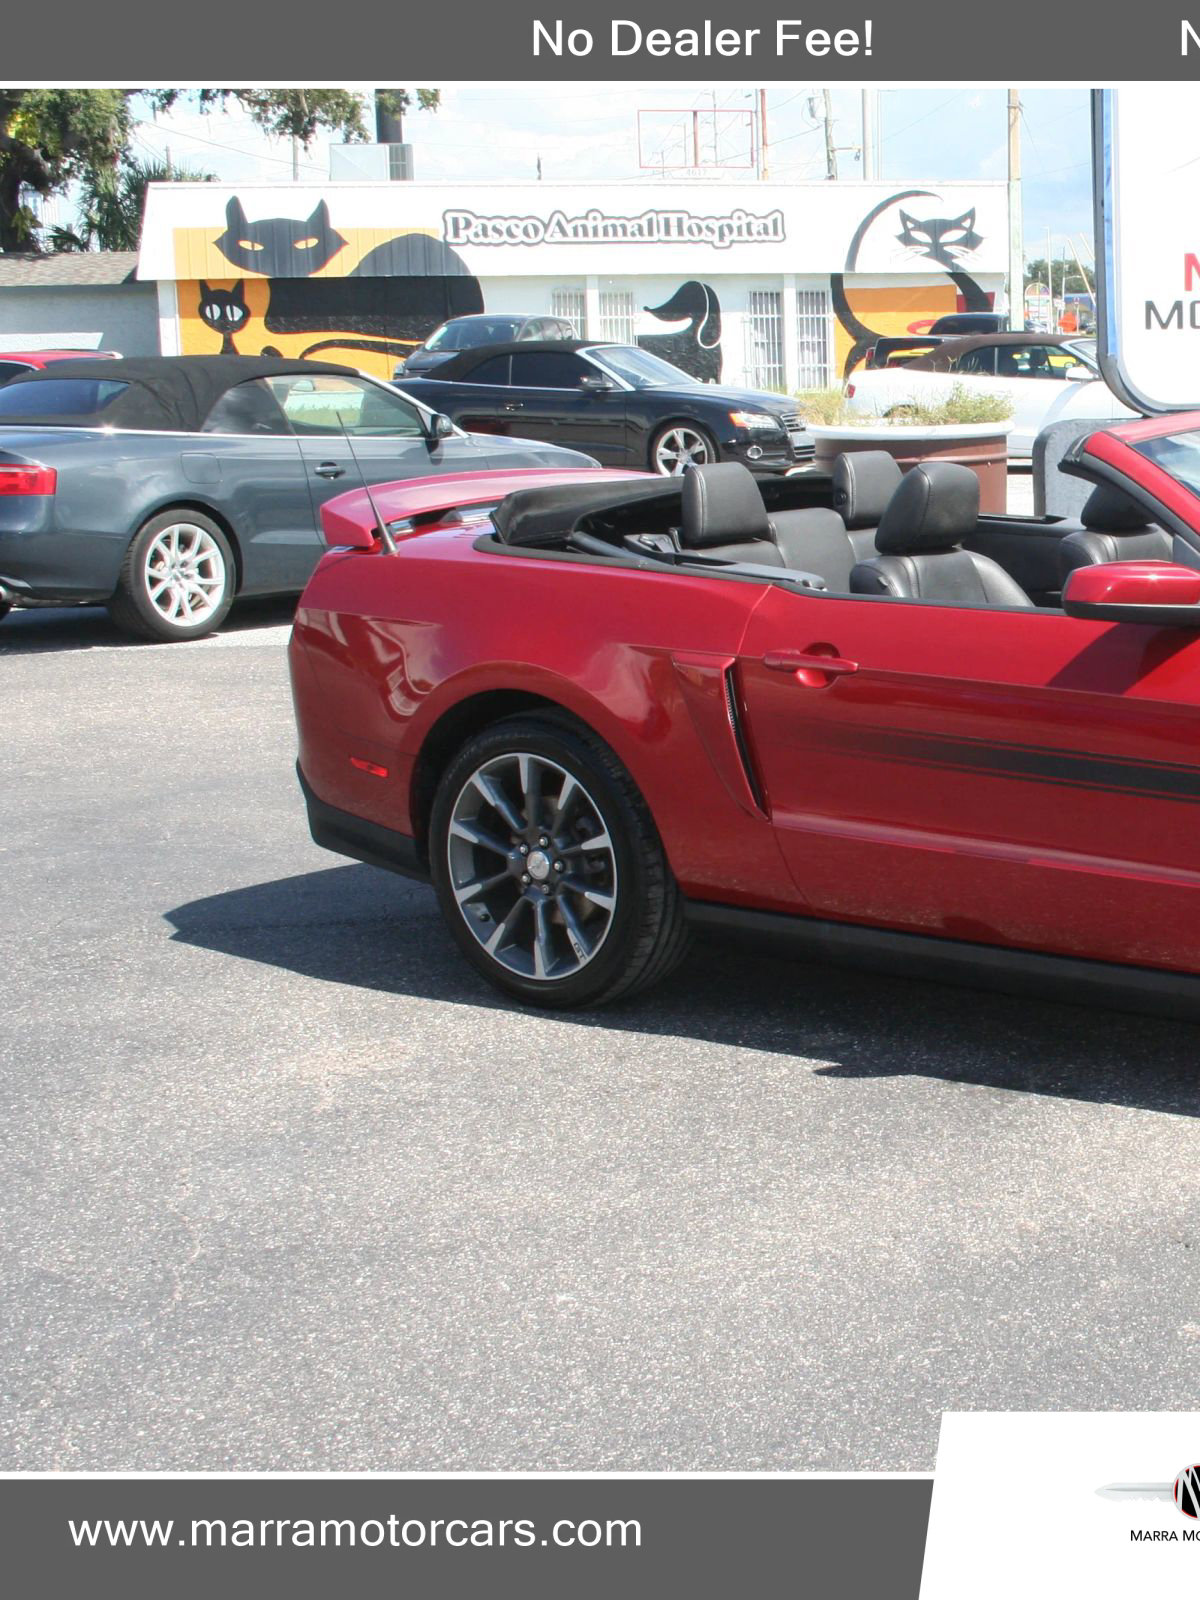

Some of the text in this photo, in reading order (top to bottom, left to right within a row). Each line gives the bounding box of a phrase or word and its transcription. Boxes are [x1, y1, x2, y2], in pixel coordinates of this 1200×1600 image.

[449, 212, 782, 243] Pasco Animal Hospital
